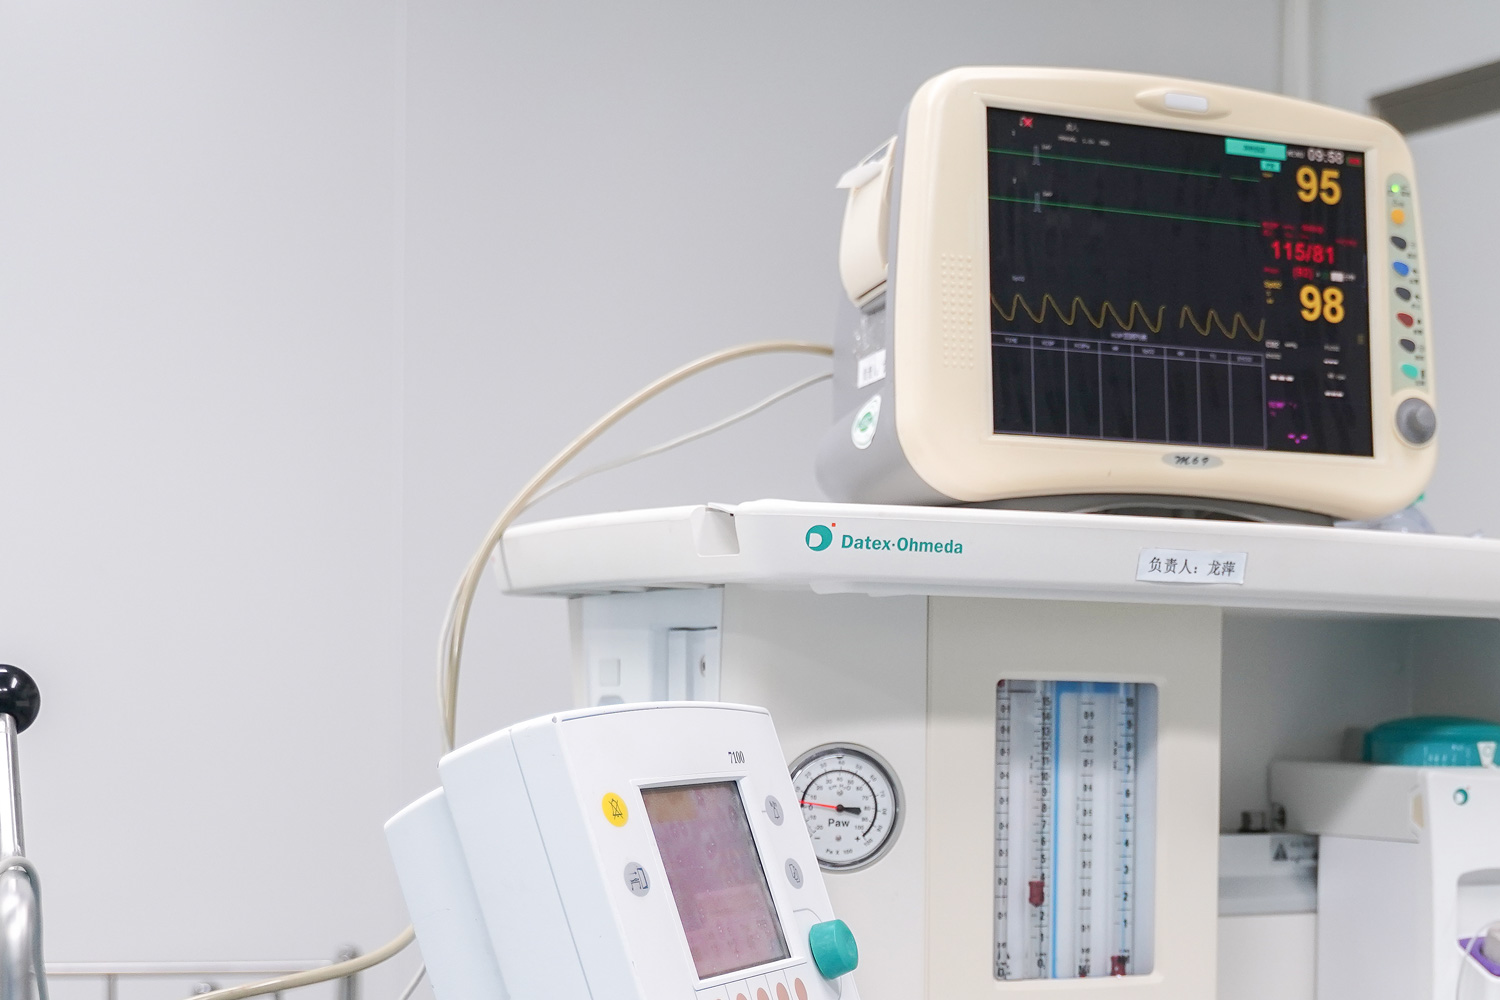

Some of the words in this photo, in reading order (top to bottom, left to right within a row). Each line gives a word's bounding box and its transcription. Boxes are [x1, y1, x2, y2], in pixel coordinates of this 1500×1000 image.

[1296, 165, 1342, 205] 95
[1271, 240, 1335, 265] 115/81
[1300, 284, 1345, 324] 98
[728, 751, 746, 763] 7100
[828, 818, 850, 828] Paw
